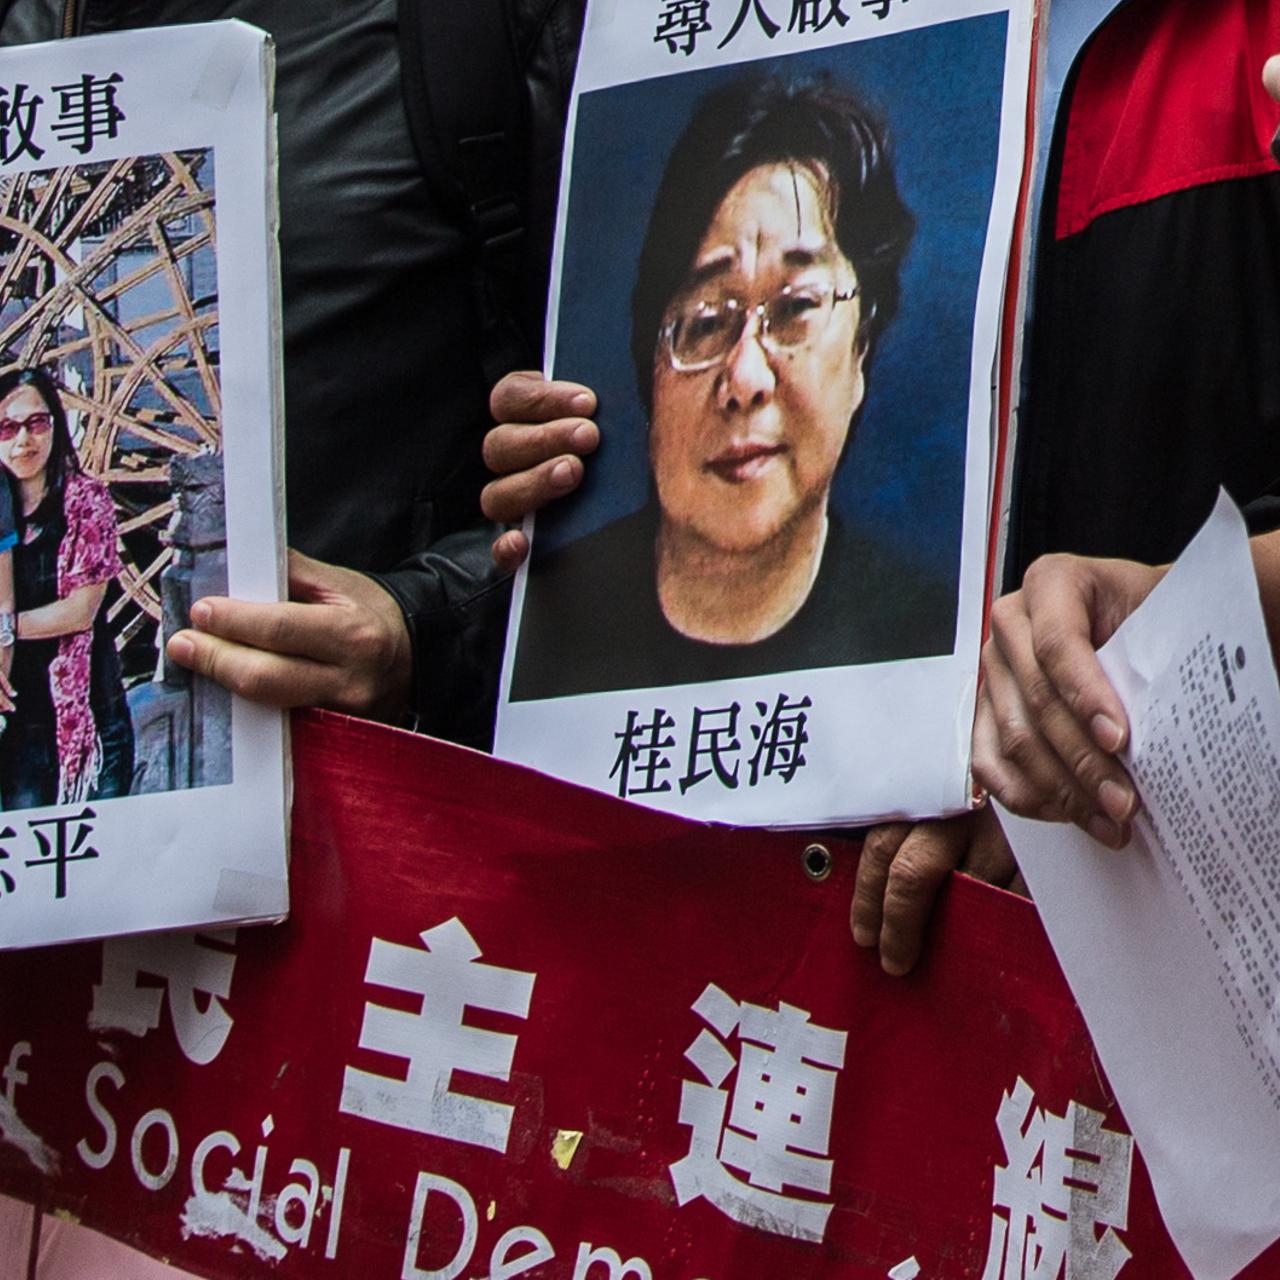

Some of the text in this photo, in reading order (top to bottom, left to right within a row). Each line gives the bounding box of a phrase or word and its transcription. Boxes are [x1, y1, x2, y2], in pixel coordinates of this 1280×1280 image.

[608, 693, 813, 799] 桂民海
[0, 806, 99, 899] 平
[76, 1061, 351, 1259] Social
